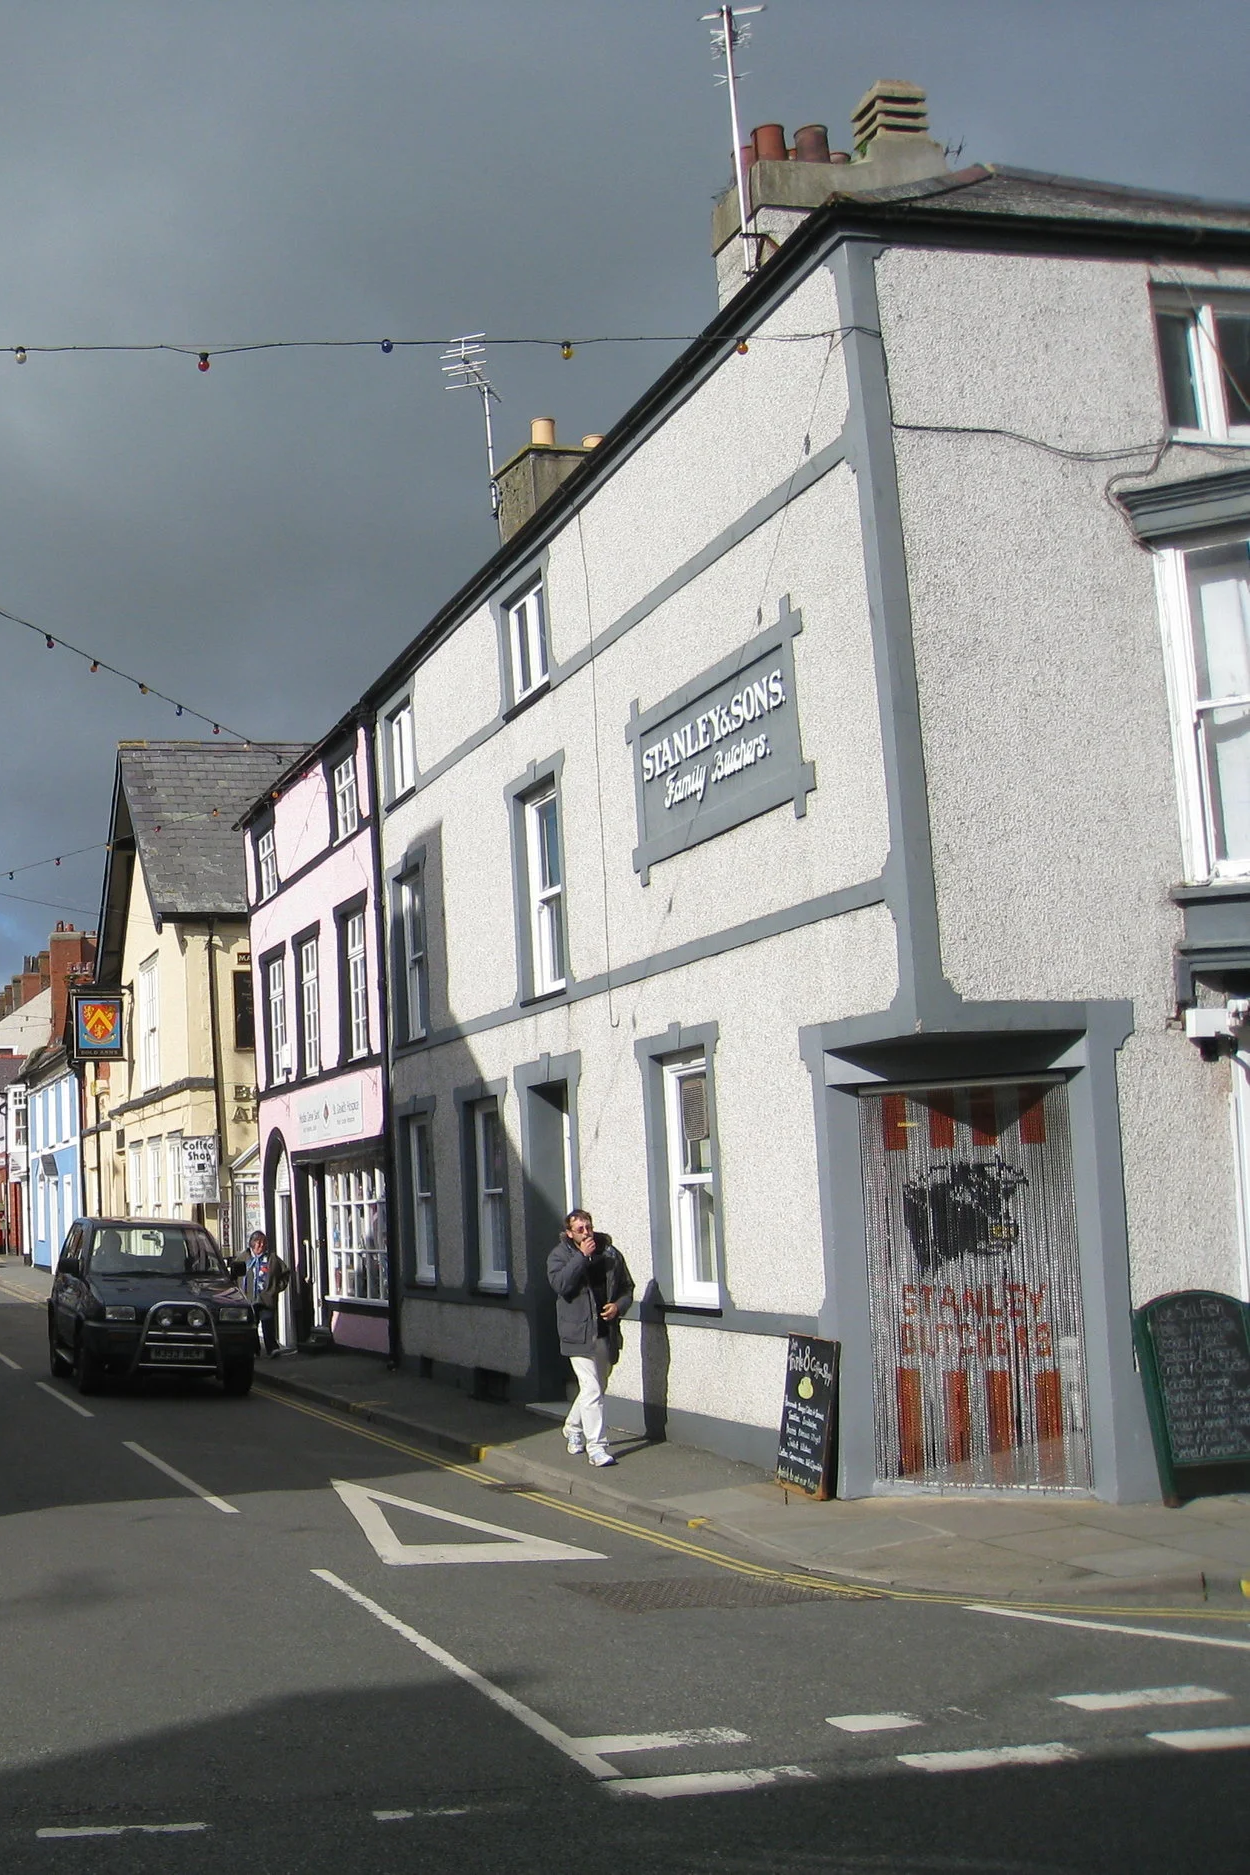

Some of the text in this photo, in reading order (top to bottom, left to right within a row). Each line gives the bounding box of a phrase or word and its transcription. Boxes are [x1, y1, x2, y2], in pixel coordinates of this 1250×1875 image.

[664, 765, 707, 809] Family
[182, 1141, 214, 1151] Coffee
[188, 1152, 211, 1162] Shop
[902, 1283, 1047, 1317] STANLEY
